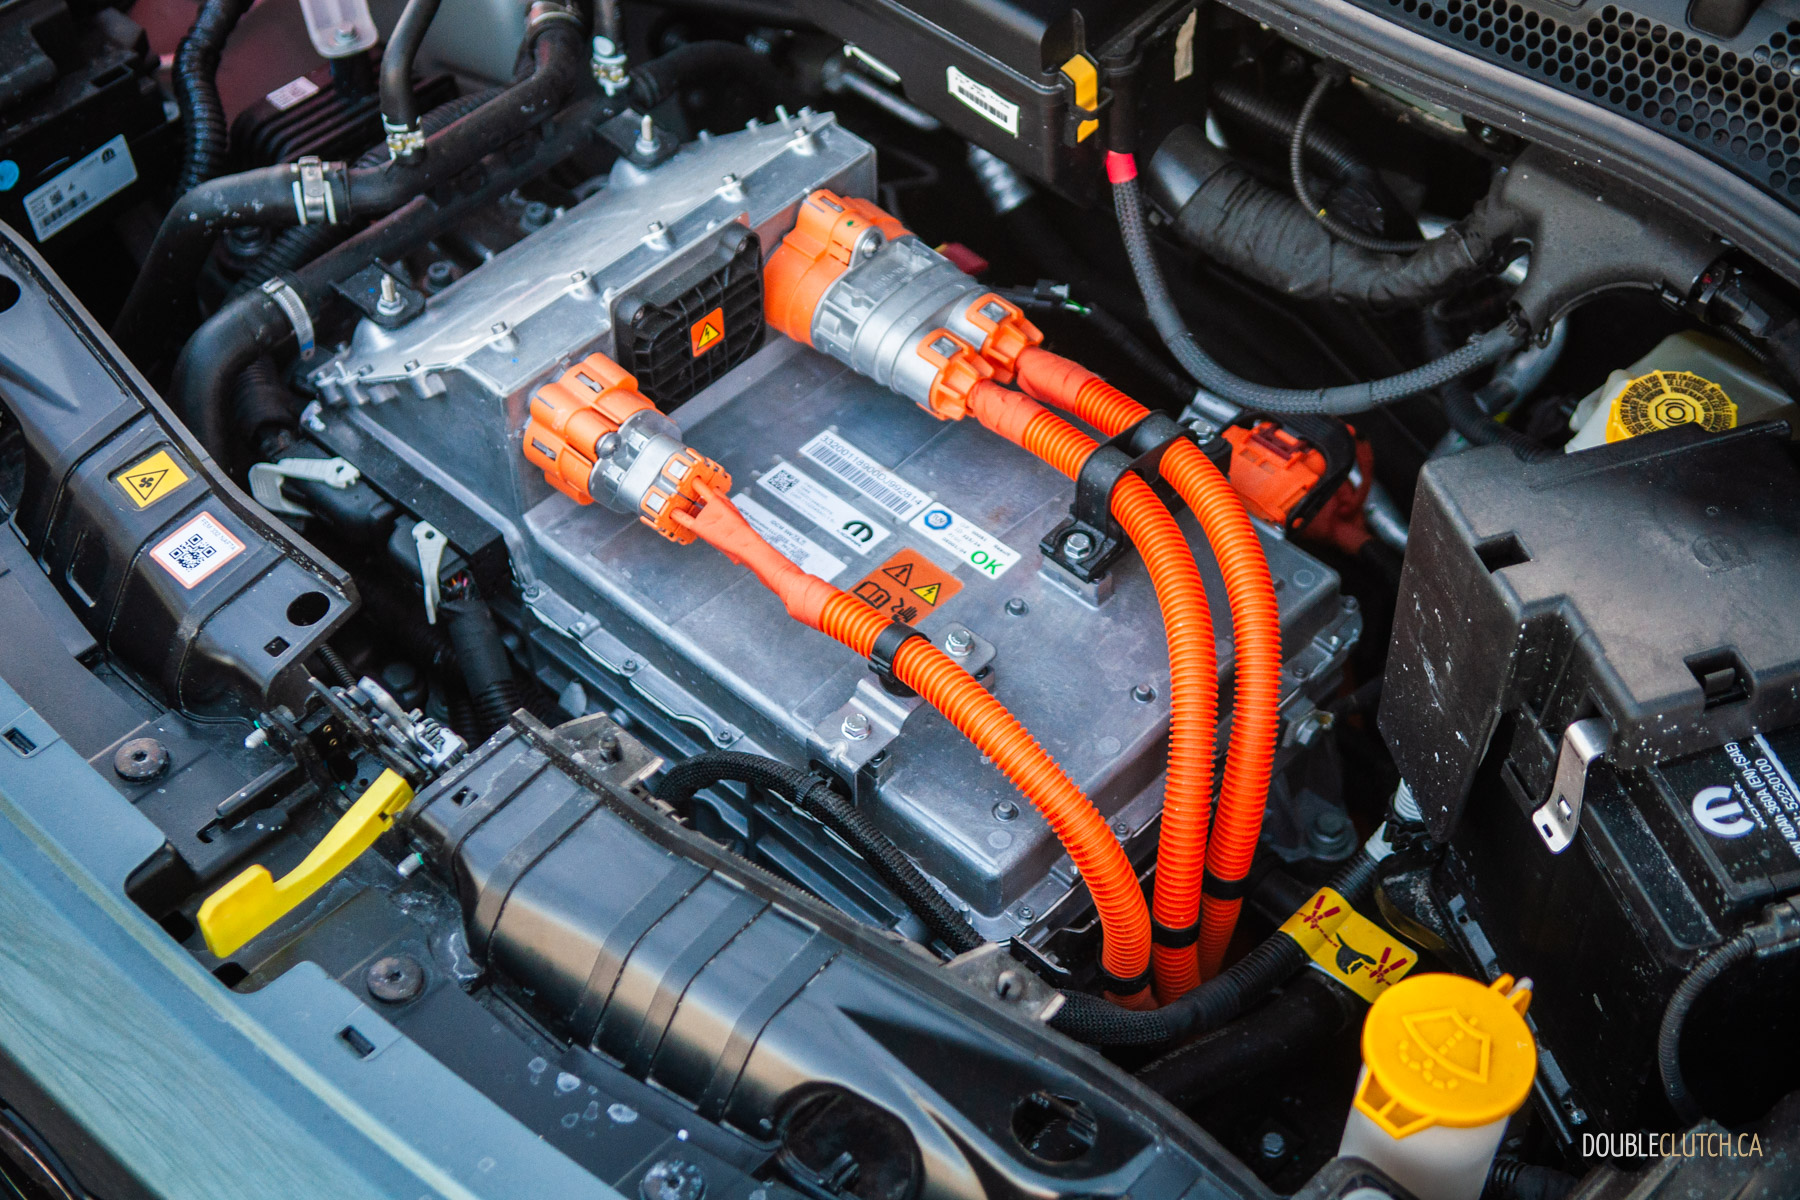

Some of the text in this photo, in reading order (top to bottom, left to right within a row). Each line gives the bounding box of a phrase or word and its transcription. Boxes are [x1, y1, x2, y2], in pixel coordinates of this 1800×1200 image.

[971, 550, 1004, 575] OK
[1755, 758, 1799, 810] 52230100
[1756, 787, 1781, 815] 360A
[1775, 813, 1797, 840] 40Ah
